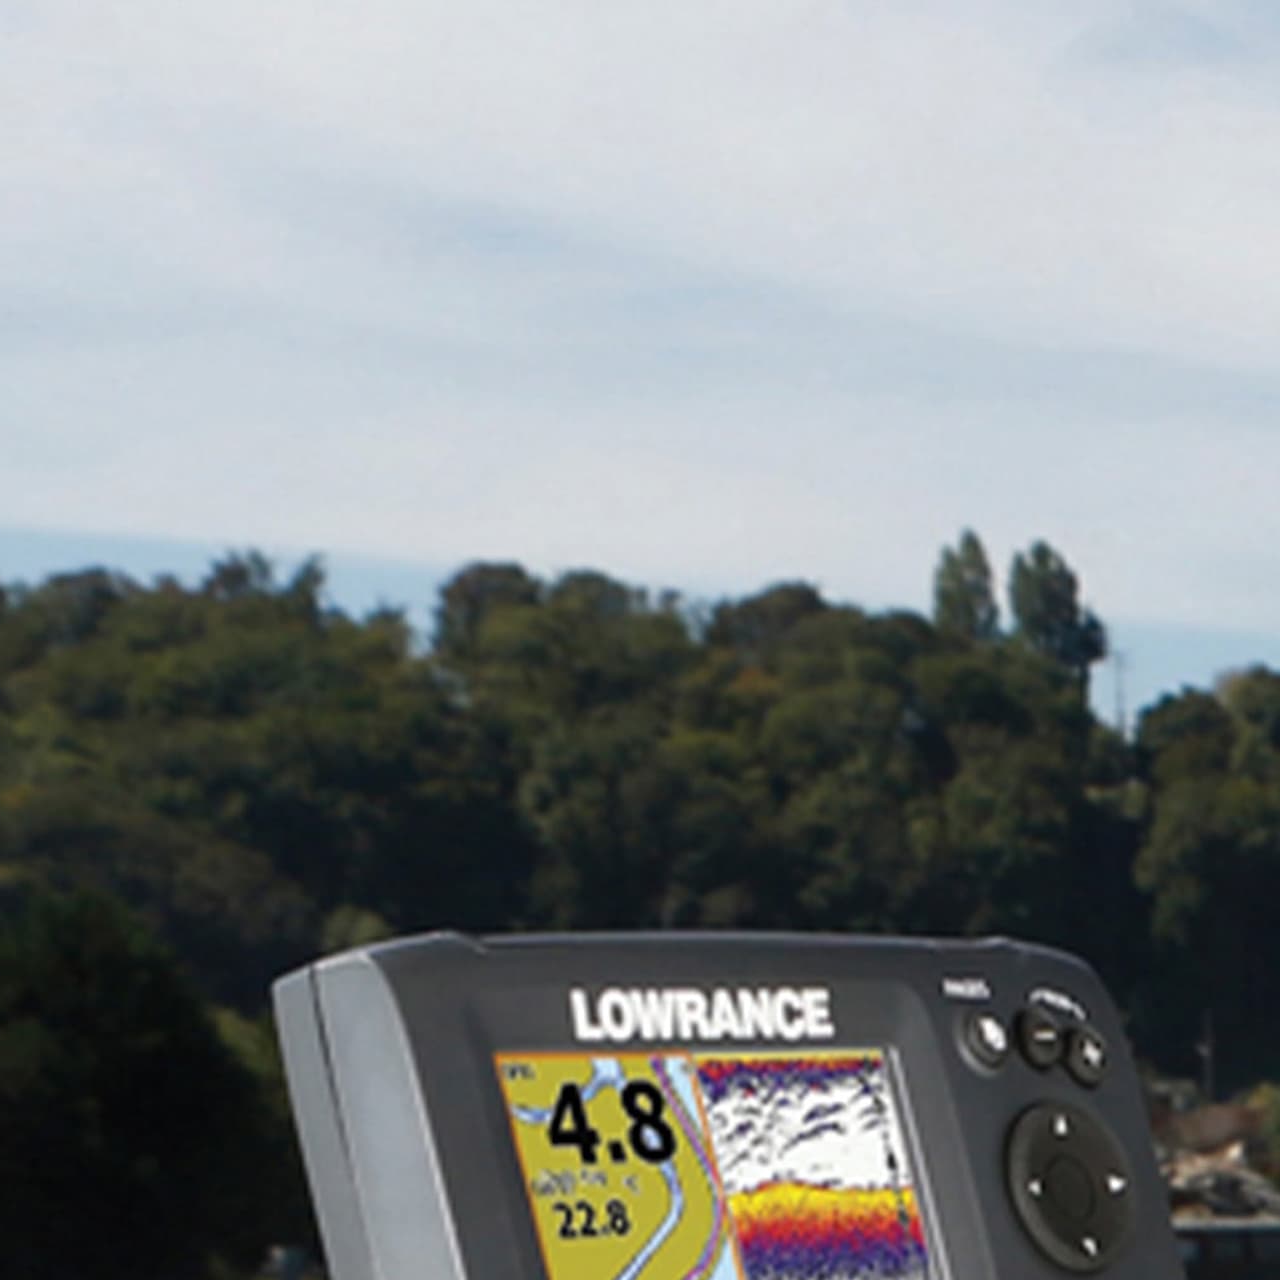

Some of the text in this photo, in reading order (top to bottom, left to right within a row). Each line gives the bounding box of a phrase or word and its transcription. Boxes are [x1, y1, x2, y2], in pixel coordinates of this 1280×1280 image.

[570, 988, 835, 1041] LOWRANCE
[548, 1081, 676, 1164] 4.8
[554, 1200, 630, 1238] 22.8
